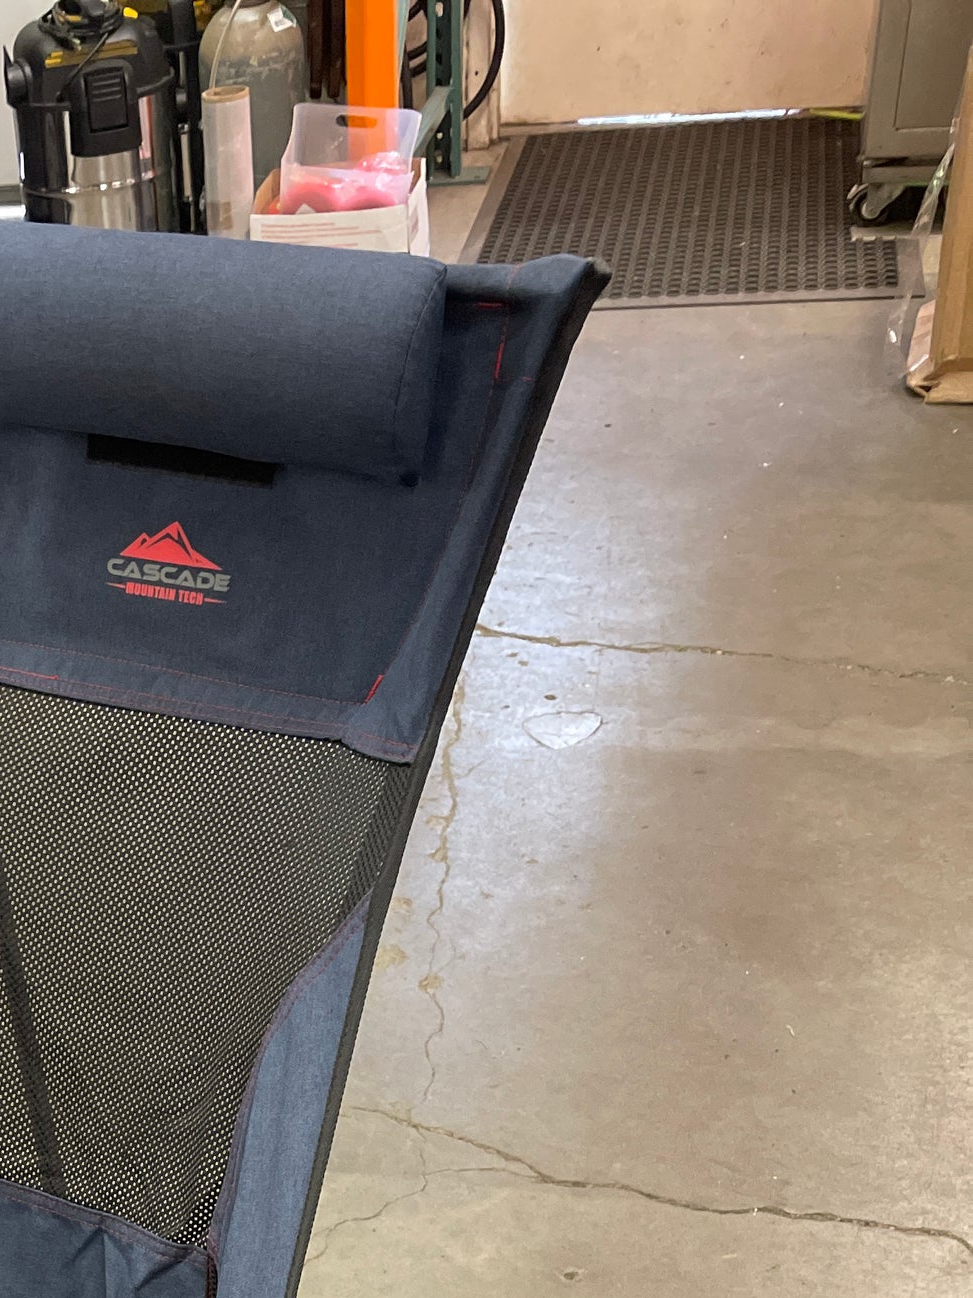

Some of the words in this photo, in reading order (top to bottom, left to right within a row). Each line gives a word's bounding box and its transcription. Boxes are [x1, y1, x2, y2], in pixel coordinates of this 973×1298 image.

[107, 558, 232, 592] CASCADE
[125, 582, 177, 601] MOUNTAIN
[178, 589, 204, 605] TECH
